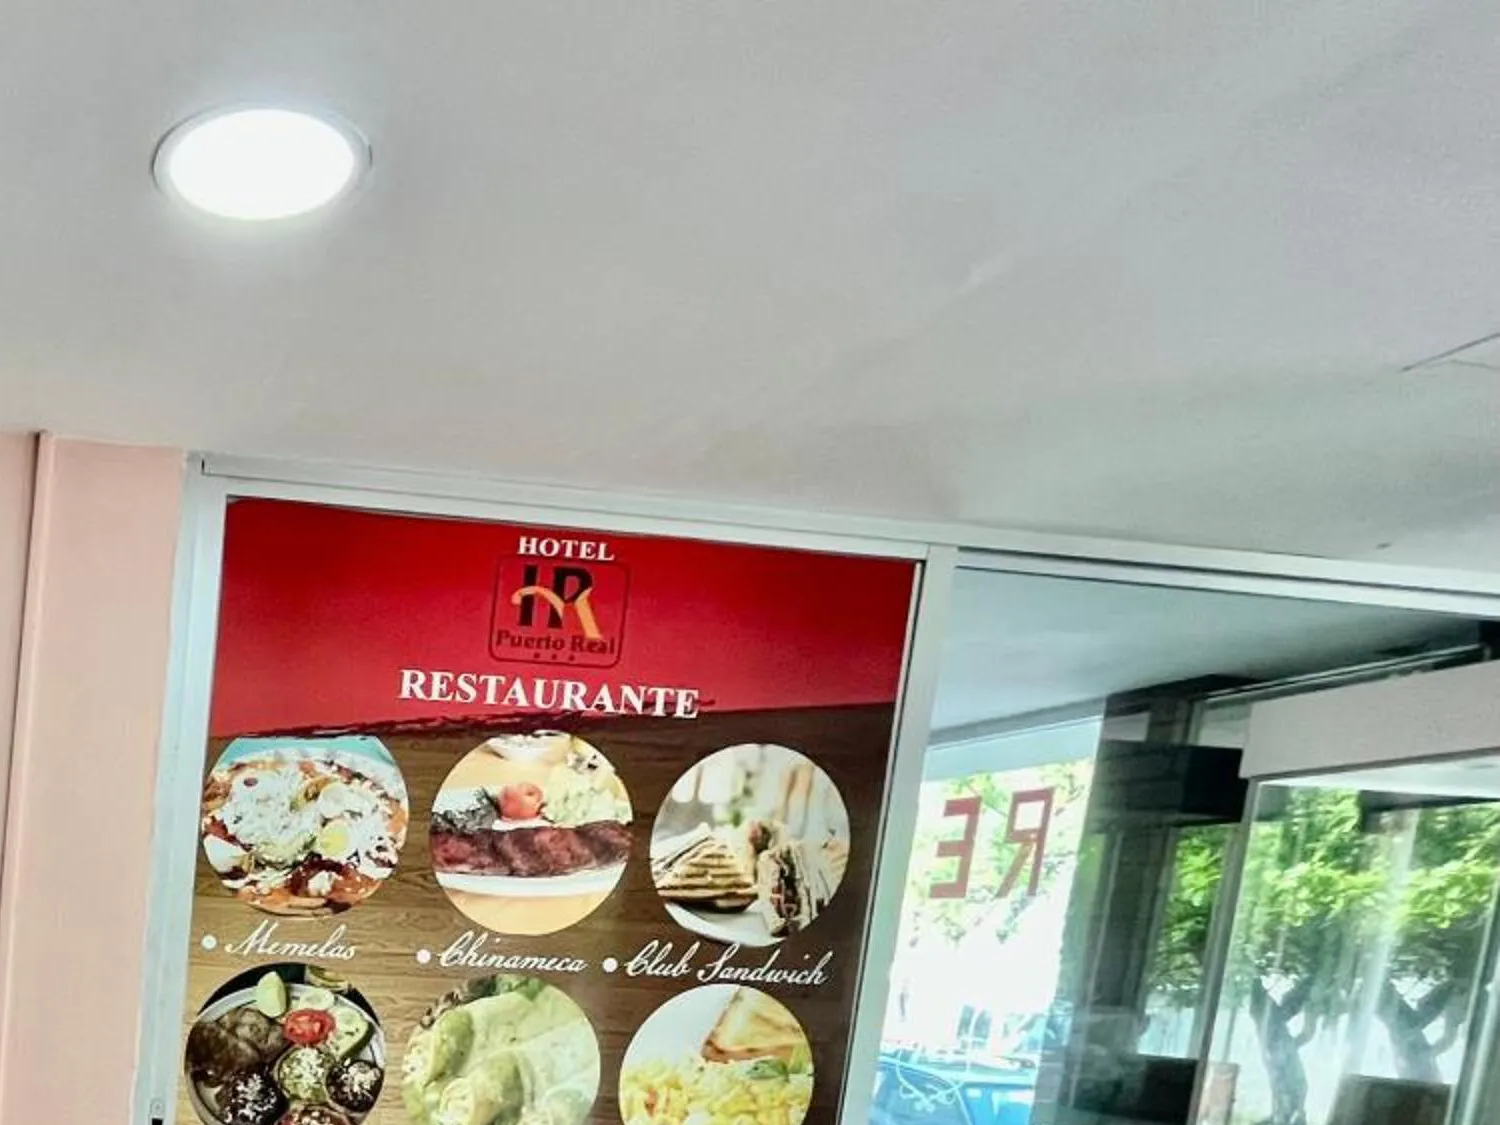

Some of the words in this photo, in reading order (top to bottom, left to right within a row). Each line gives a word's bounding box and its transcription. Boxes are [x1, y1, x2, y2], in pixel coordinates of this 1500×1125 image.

[517, 536, 615, 562] HOTEL
[496, 629, 566, 652] Puerto
[570, 635, 616, 655] Real
[399, 668, 700, 719] RESTAURANTE
[224, 919, 357, 961] Memelas
[437, 930, 589, 974] Chinameca
[624, 938, 702, 979] Club
[696, 942, 834, 987] Sandwich
